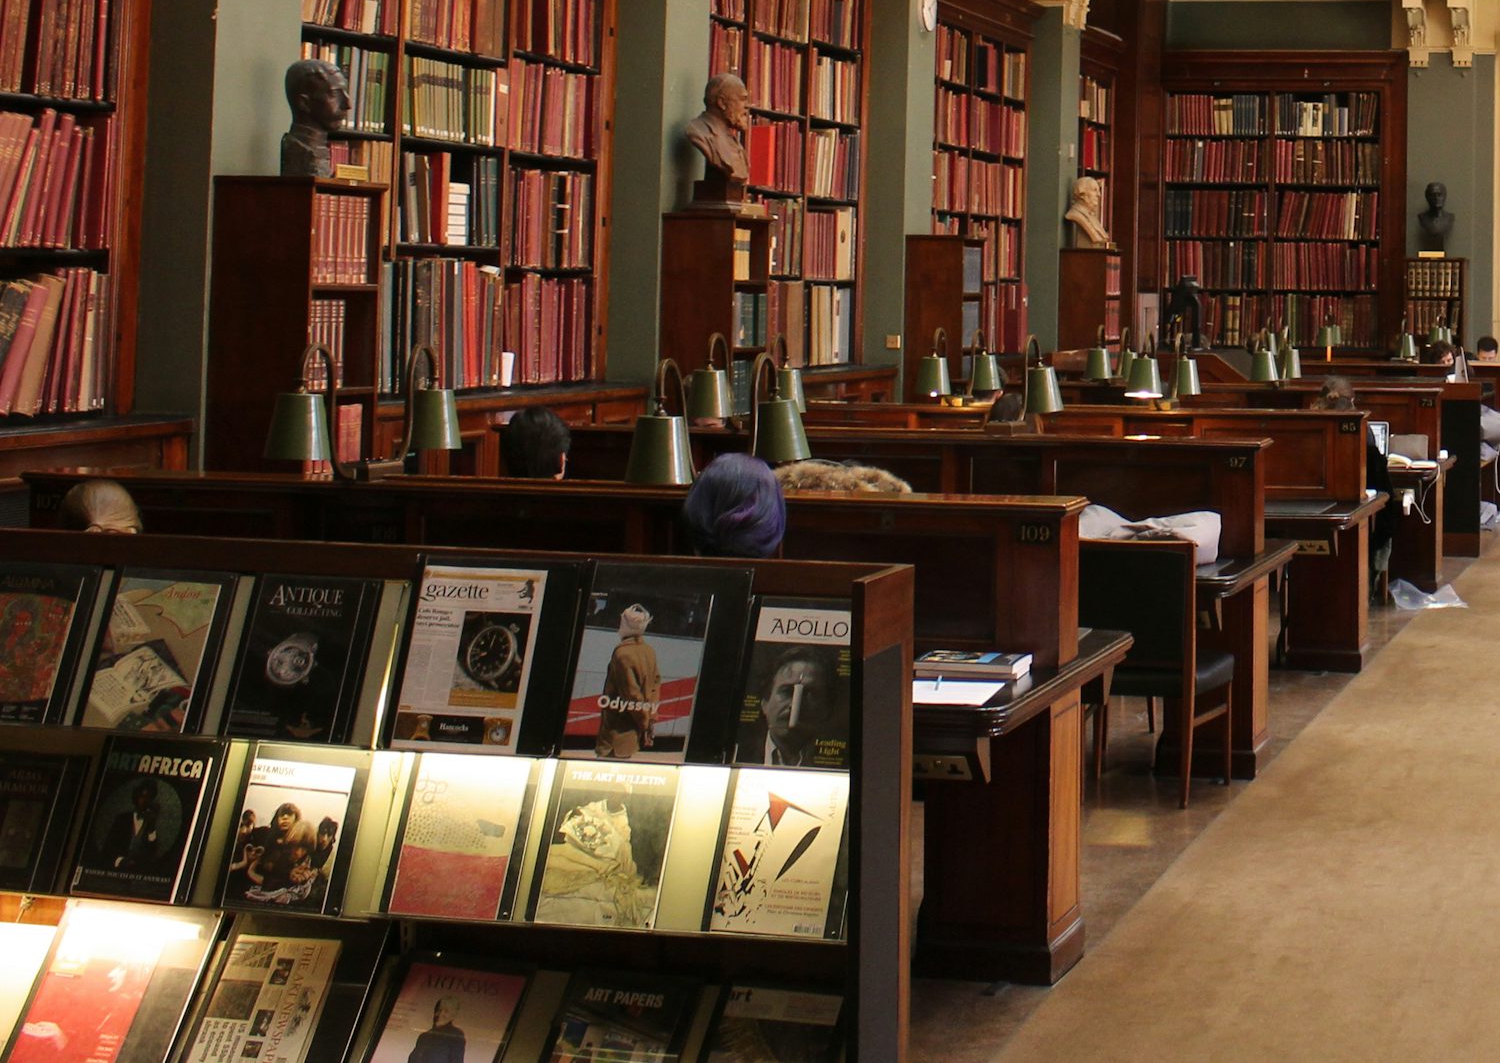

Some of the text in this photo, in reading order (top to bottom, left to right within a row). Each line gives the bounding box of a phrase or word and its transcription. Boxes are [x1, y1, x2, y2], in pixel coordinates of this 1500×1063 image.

[1342, 423, 1356, 432] 85
[1229, 457, 1247, 468] 97
[1020, 525, 1050, 541] 109
[269, 585, 344, 608] ANTIQUE
[420, 583, 489, 602] gazette
[286, 607, 342, 618] COLLECTING
[770, 618, 849, 638] APOLLO
[597, 695, 659, 714] Odyssey
[819, 747, 840, 756] Light
[571, 770, 666, 786] THE ART BULLETIN
[299, 945, 316, 970] THE
[287, 976, 305, 997] ART
[584, 987, 665, 1009] ART PAPERS
